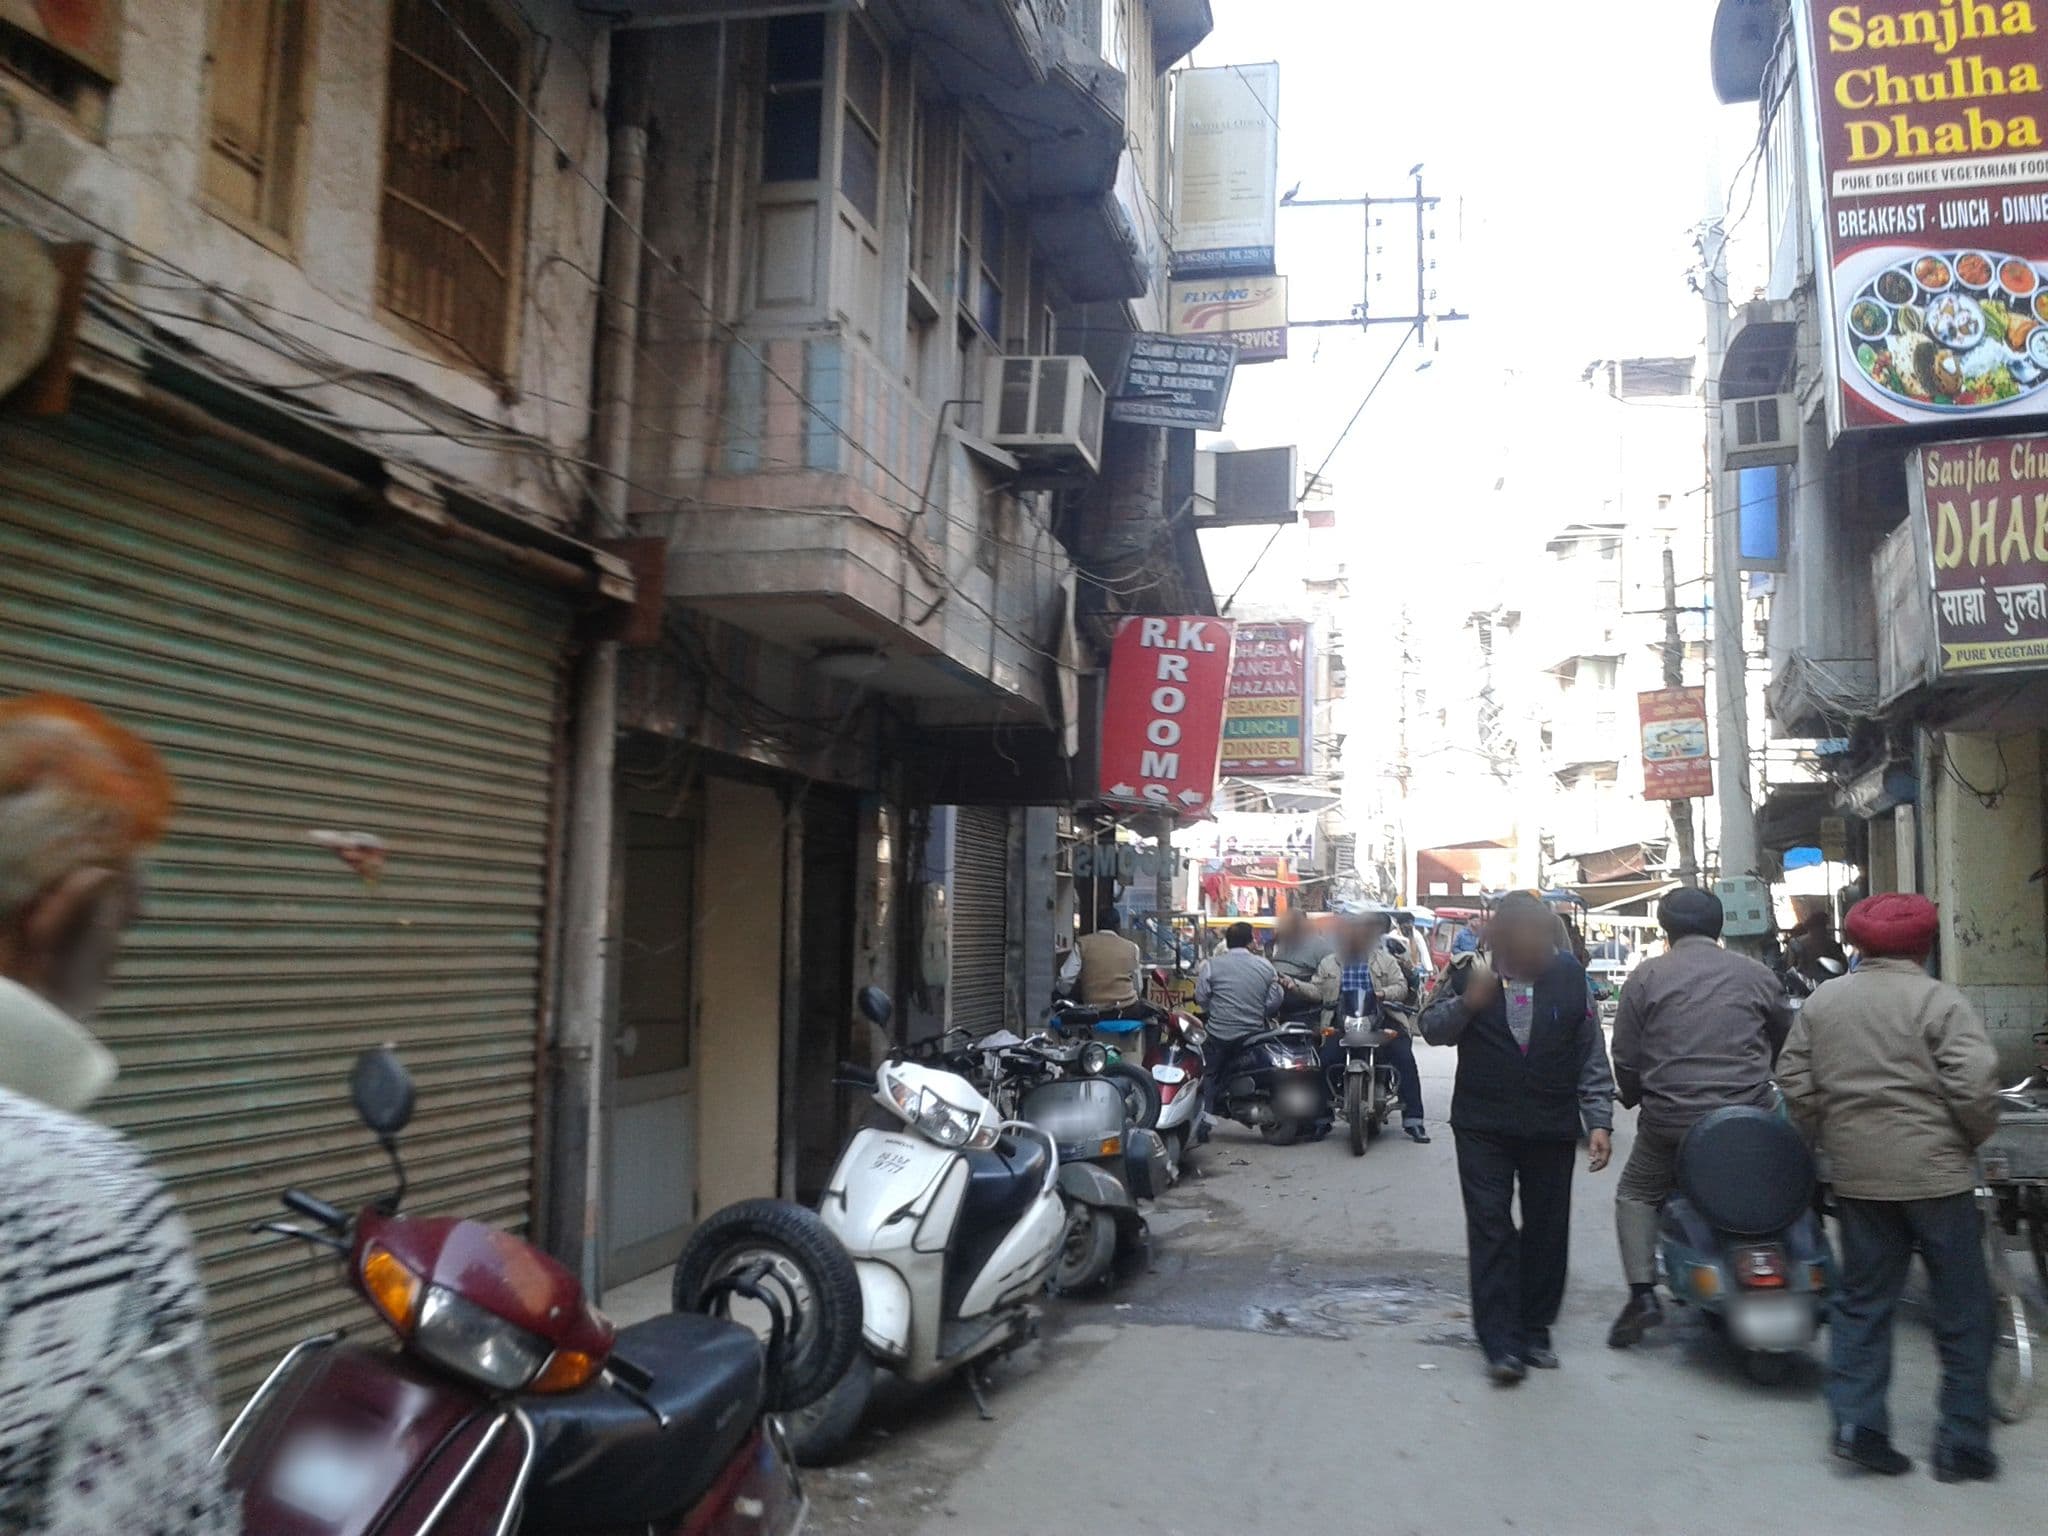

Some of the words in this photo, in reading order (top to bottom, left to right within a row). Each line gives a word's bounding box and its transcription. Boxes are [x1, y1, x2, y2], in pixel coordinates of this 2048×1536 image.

[1828, 0, 2037, 54] Sanjha
[1834, 55, 2043, 109] Chulha
[1843, 107, 2043, 162] Dhaba
[1841, 175, 1873, 191] PURE
[1876, 172, 1904, 187] DESI
[1907, 169, 1938, 185] GHEE
[1941, 162, 2017, 182] VEGETARIAN
[1838, 203, 1926, 238] BREAKFAST
[1938, 198, 1990, 230] LUNCH
[1184, 288, 1249, 303] FLYKING
[1927, 444, 2000, 495] Sanjha
[1140, 617, 1216, 653] R.K.
[1232, 659, 1295, 677] ANGLA
[1956, 648, 1987, 662] PURE
[1140, 654, 1189, 802] ROOMS
[1228, 719, 1288, 736] LUNCH
[1223, 740, 1291, 756] DINNER
